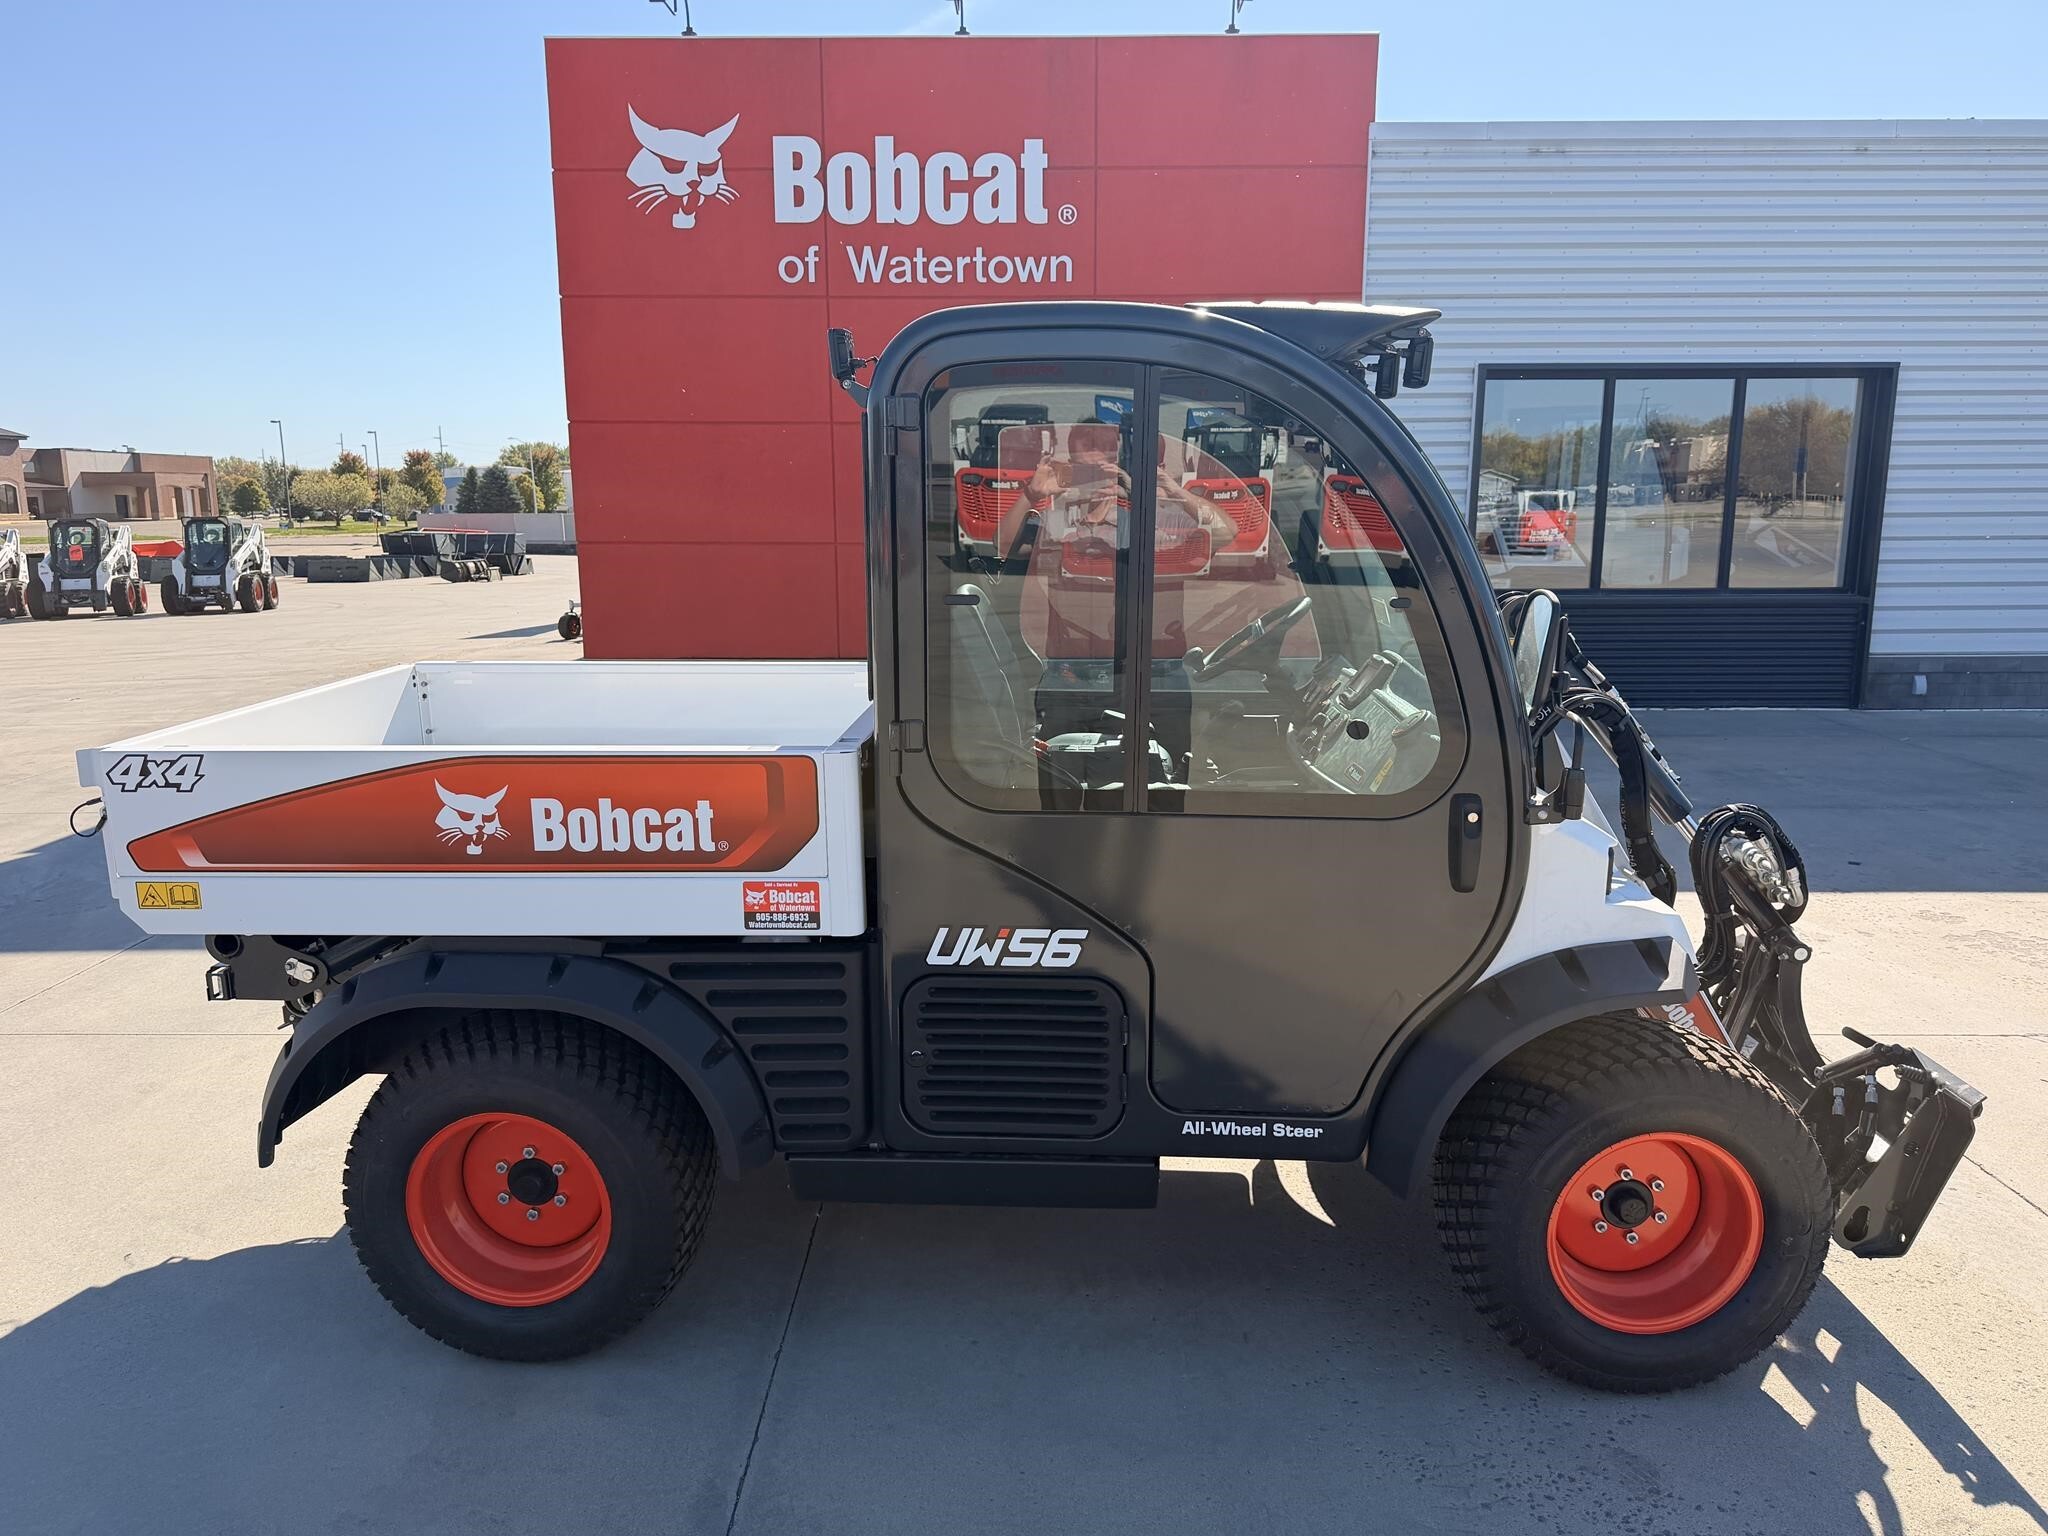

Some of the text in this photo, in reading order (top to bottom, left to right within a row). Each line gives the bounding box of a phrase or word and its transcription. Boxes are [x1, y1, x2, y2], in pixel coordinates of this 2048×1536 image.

[773, 135, 1048, 226] Bobcat
[777, 245, 1073, 284] of Watertown
[106, 754, 205, 793] 4x4
[530, 797, 716, 853] Bobcat
[769, 889, 816, 904] Bobcat
[770, 904, 816, 912] of Watertown
[748, 921, 817, 929] WatertownBobcat.com
[1181, 1121, 1324, 1138] All-Wheel Steer
